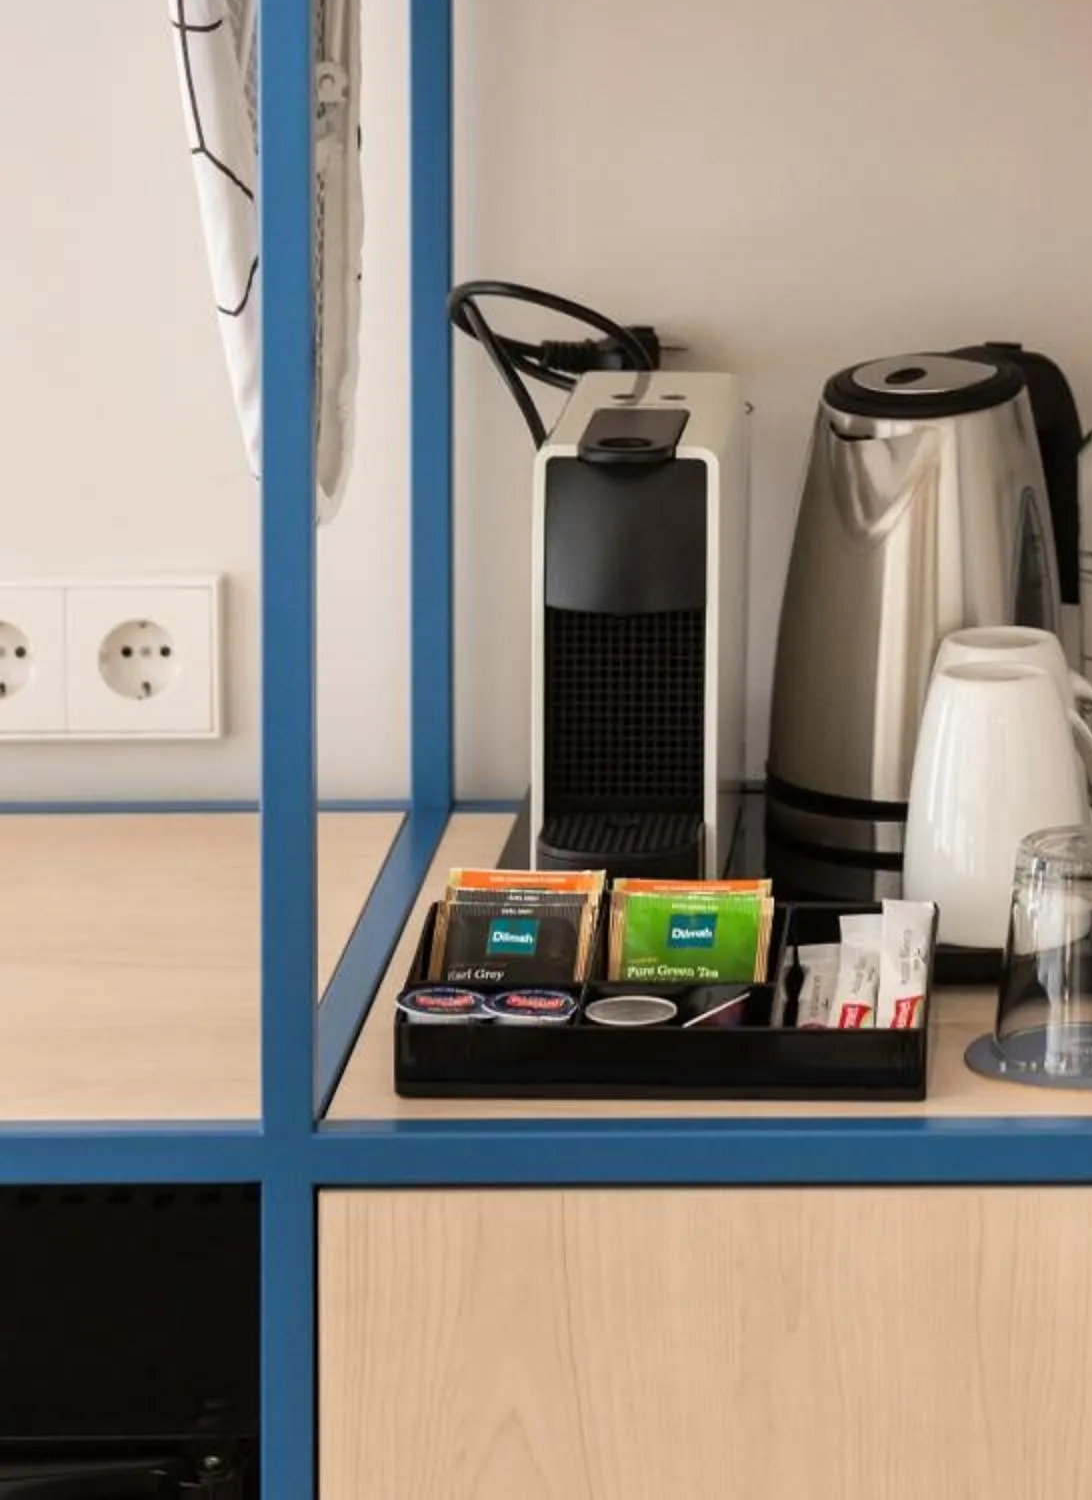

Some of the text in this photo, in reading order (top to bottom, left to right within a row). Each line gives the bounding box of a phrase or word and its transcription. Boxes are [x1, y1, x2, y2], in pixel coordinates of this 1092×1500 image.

[492, 931, 534, 945] Dilmah
[671, 927, 713, 940] Dilmah
[474, 969, 504, 982] Grey
[627, 965, 720, 979] Pure Green Tea
